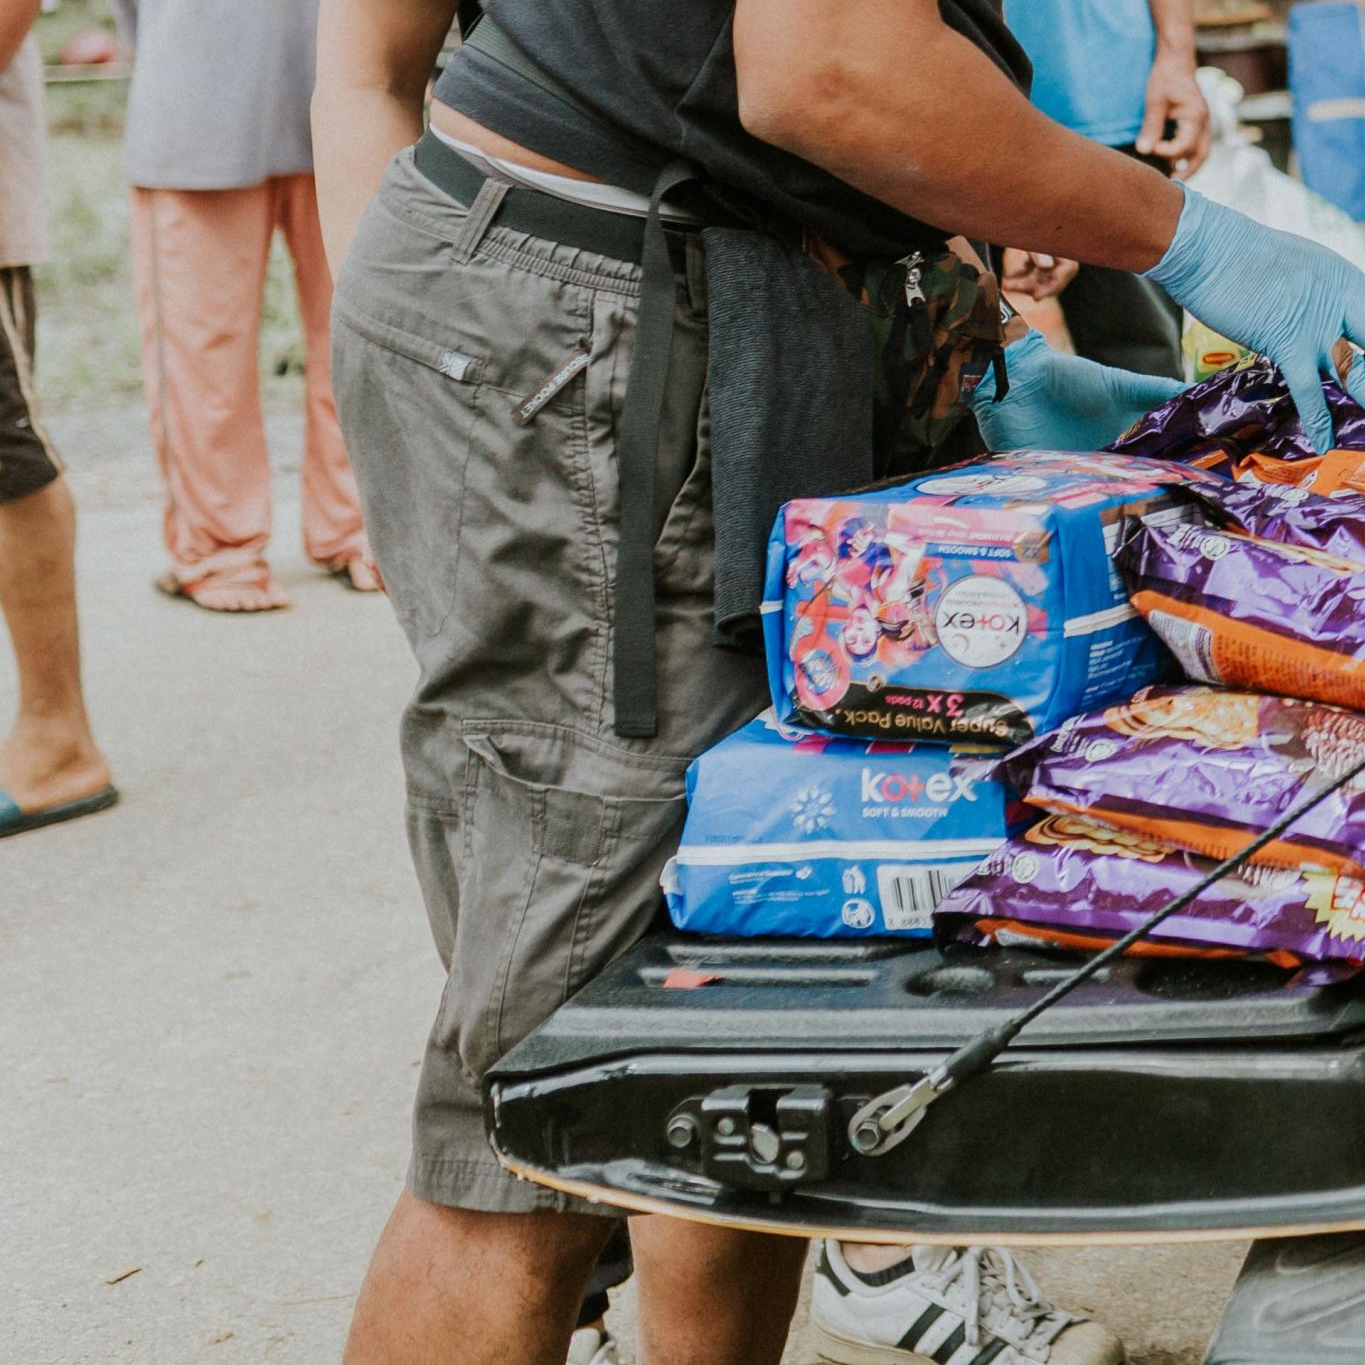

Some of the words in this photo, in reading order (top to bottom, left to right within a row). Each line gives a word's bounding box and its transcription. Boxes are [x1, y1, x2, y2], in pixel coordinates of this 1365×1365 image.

[894, 712, 945, 736] Value
[949, 716, 1010, 738] Super
[861, 806, 888, 818] SOFT
[891, 806, 900, 818] &
[900, 806, 950, 818] SMOOTH
